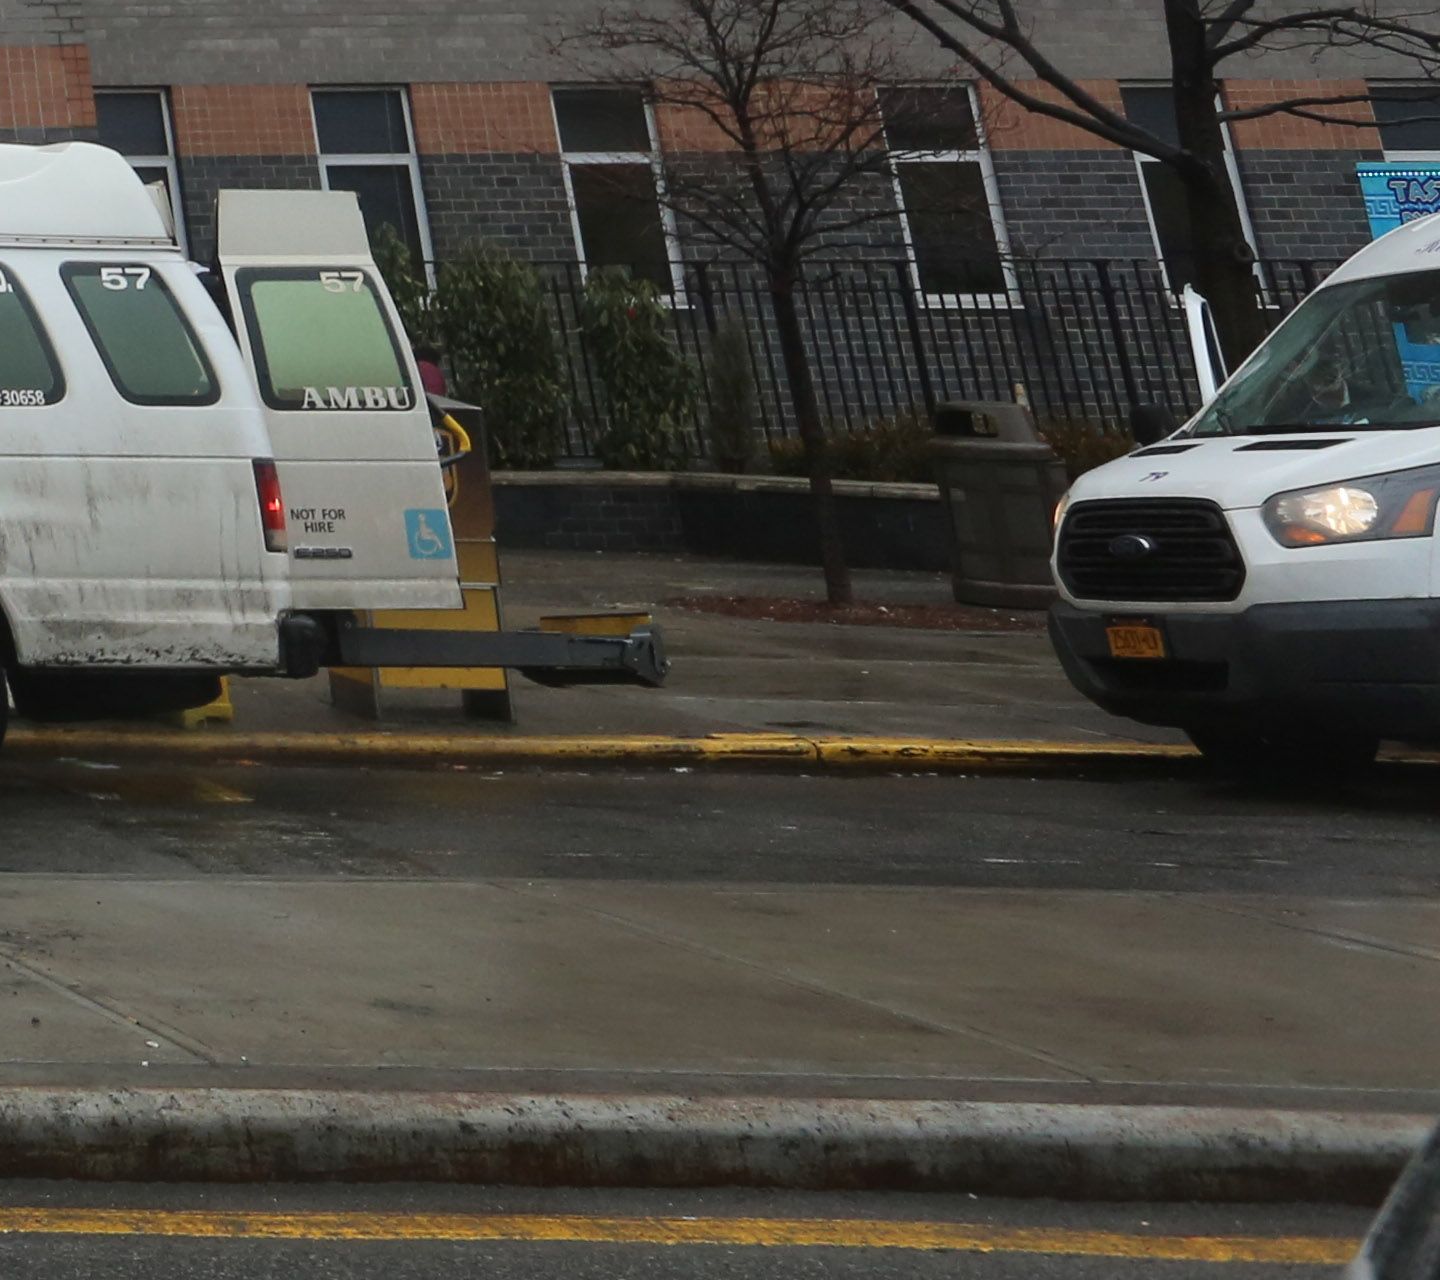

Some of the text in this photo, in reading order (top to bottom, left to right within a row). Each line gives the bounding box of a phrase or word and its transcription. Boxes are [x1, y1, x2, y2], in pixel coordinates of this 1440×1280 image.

[100, 267, 151, 291] 57
[319, 271, 365, 293] 57
[300, 386, 410, 410] AMBU
[289, 508, 347, 521] NOT FOR
[303, 520, 336, 534] HIRE
